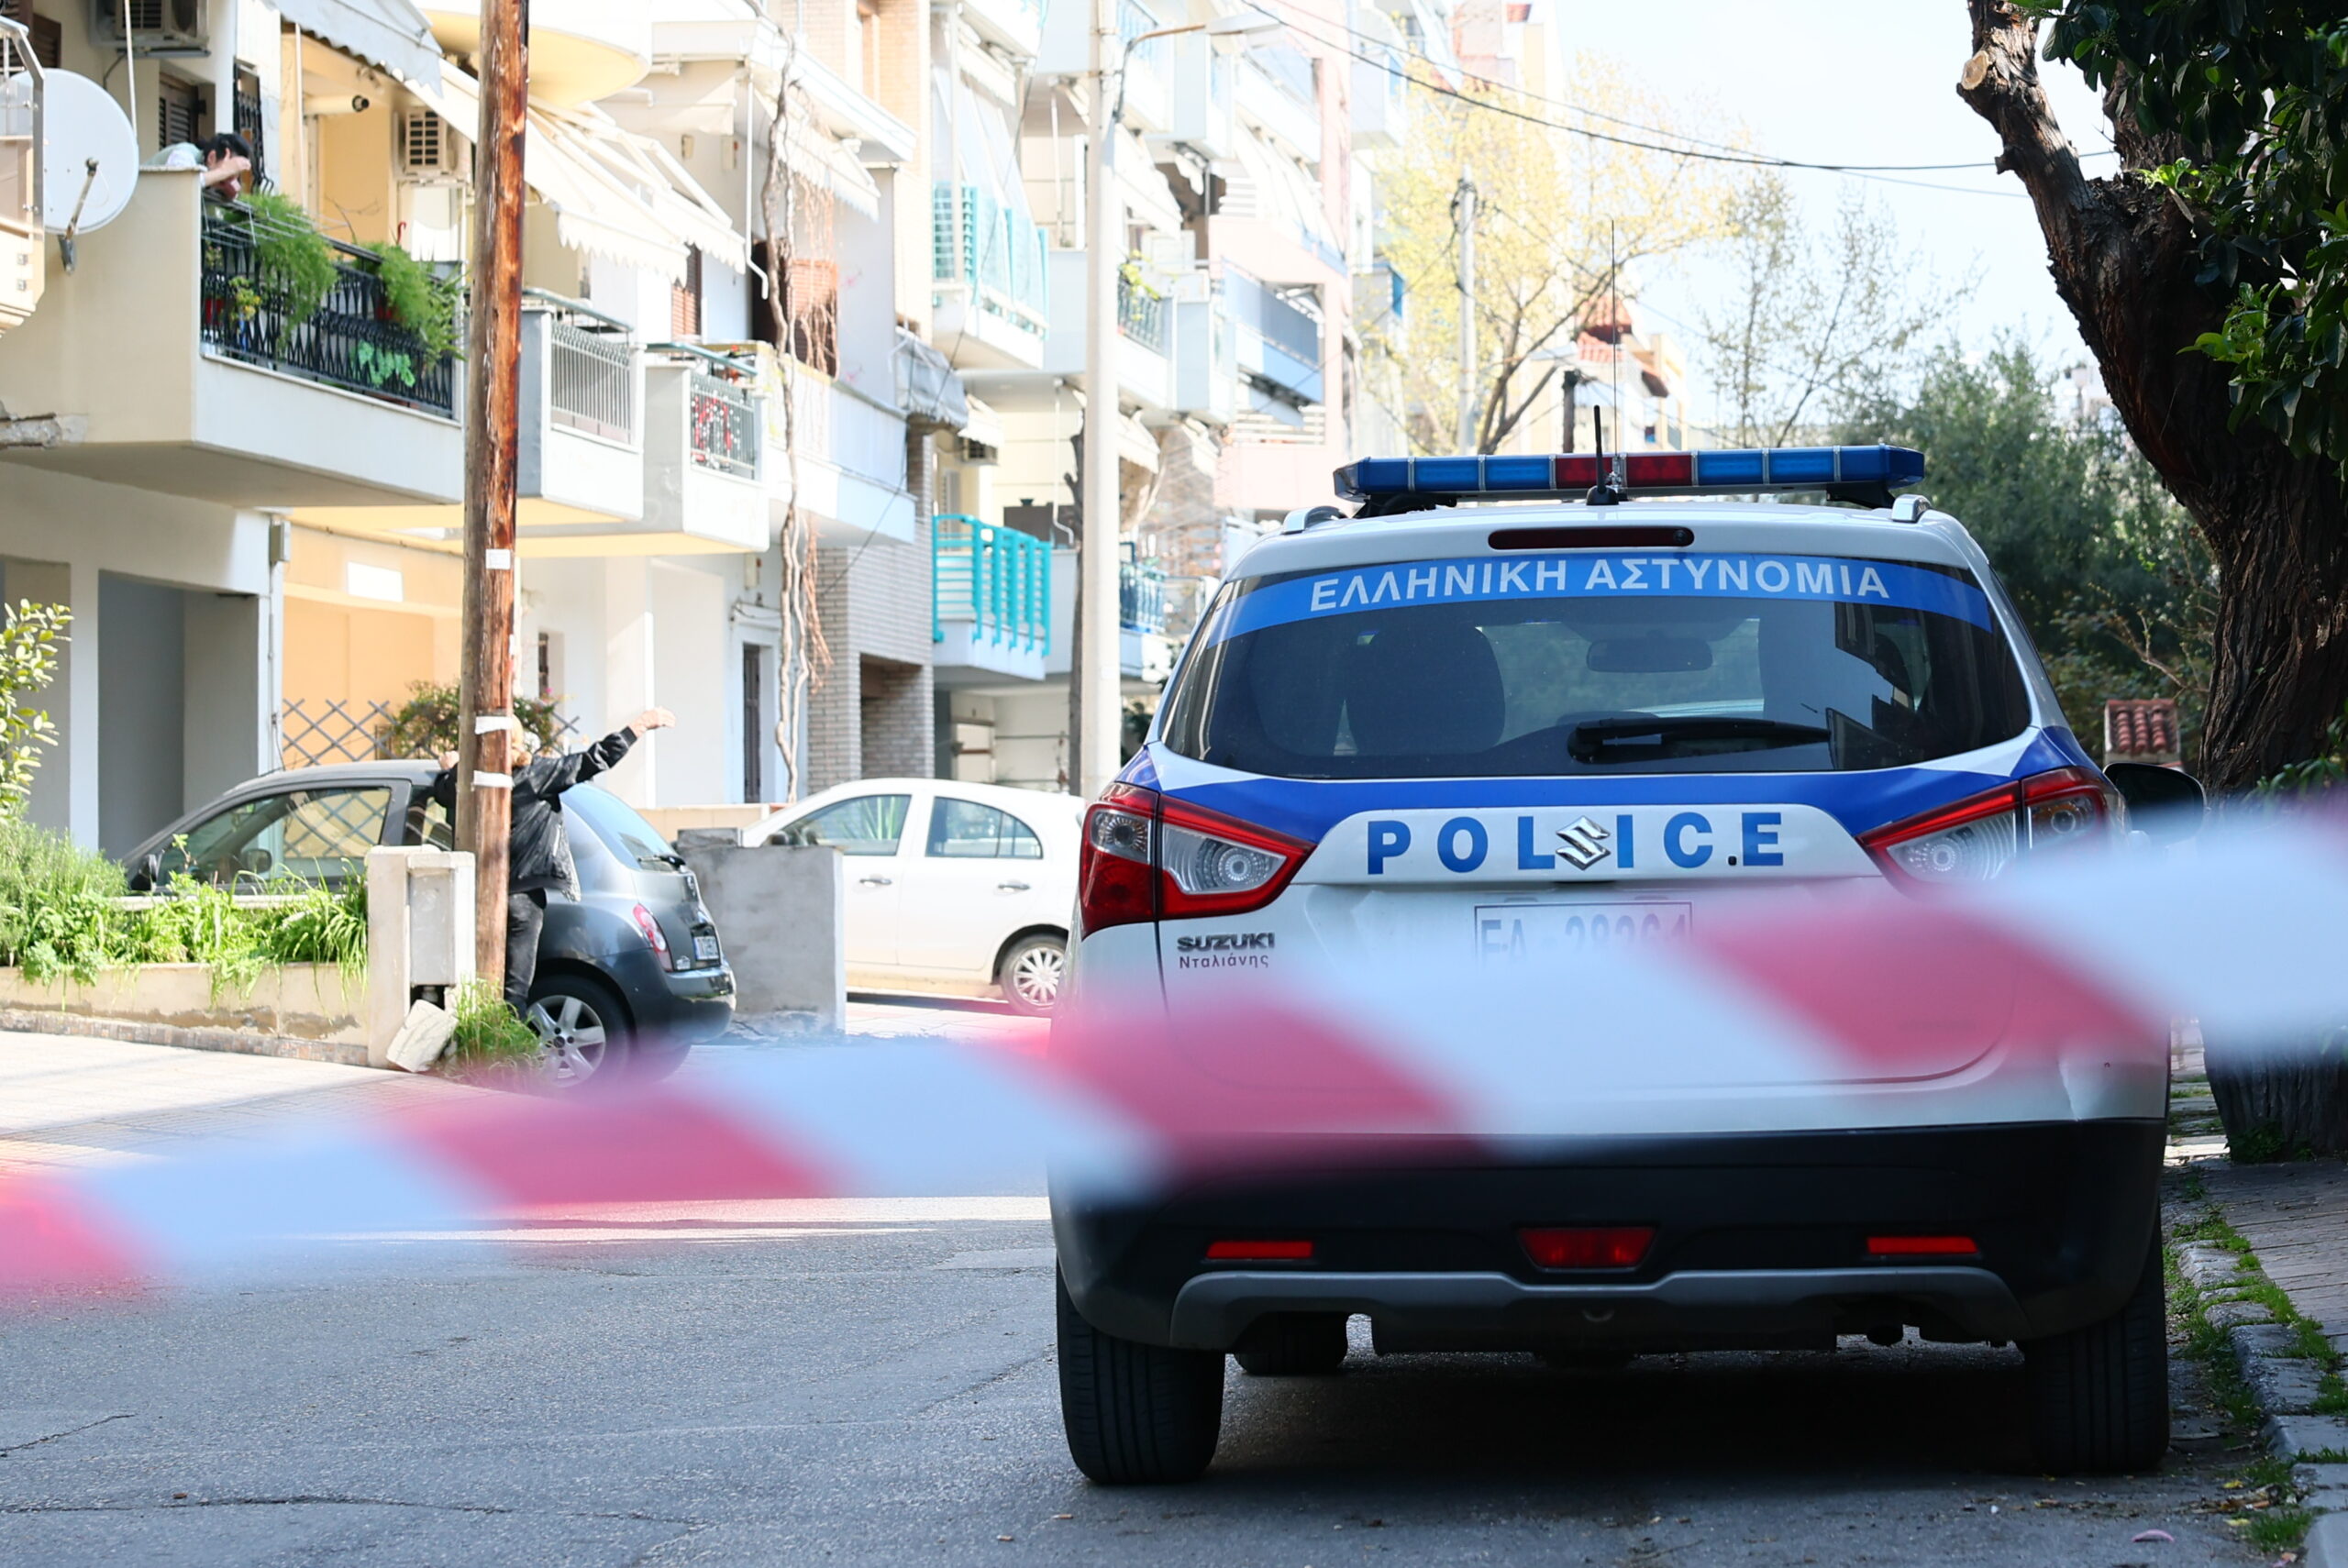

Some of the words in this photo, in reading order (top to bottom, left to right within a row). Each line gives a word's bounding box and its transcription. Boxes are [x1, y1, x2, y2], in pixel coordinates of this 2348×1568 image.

[1310, 560, 1566, 613] ΕΛΛΗΝΙΚΗ
[1585, 558, 1889, 599] ΑΣΤΥΝΟΜΙΑ
[1177, 933, 1275, 953] SUZUKI
[1180, 953, 1269, 969] Νταλιάνης
